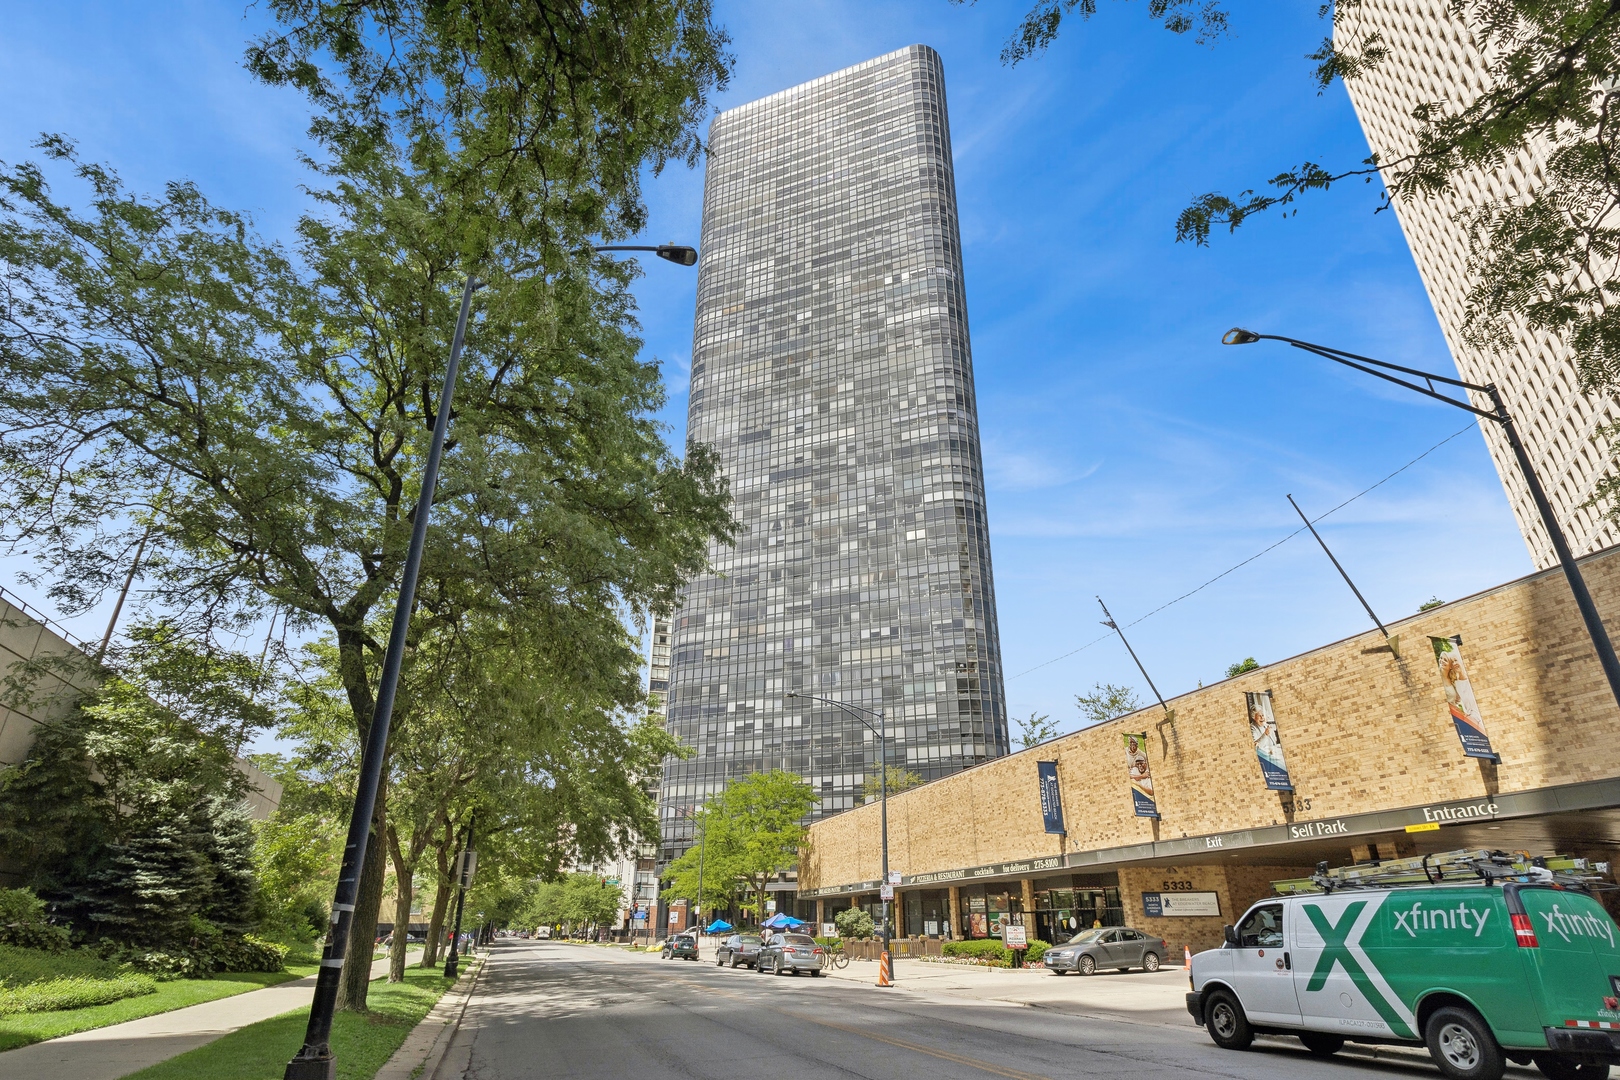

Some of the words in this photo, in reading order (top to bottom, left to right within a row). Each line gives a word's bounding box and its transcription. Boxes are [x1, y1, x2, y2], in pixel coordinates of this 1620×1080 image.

[1283, 799, 1311, 814] 5333
[1423, 803, 1500, 822] Entrance
[1292, 823, 1313, 838] Self
[1316, 820, 1348, 835] Park
[1206, 836, 1222, 848] Exit
[938, 870, 964, 880] RESTAURANT
[974, 867, 994, 876] cocktails
[1010, 864, 1030, 872] delivery
[1034, 858, 1058, 869] 275-8100
[1163, 881, 1192, 890] 5333
[1394, 902, 1490, 937] xfinity
[1539, 904, 1615, 948] xfinity
